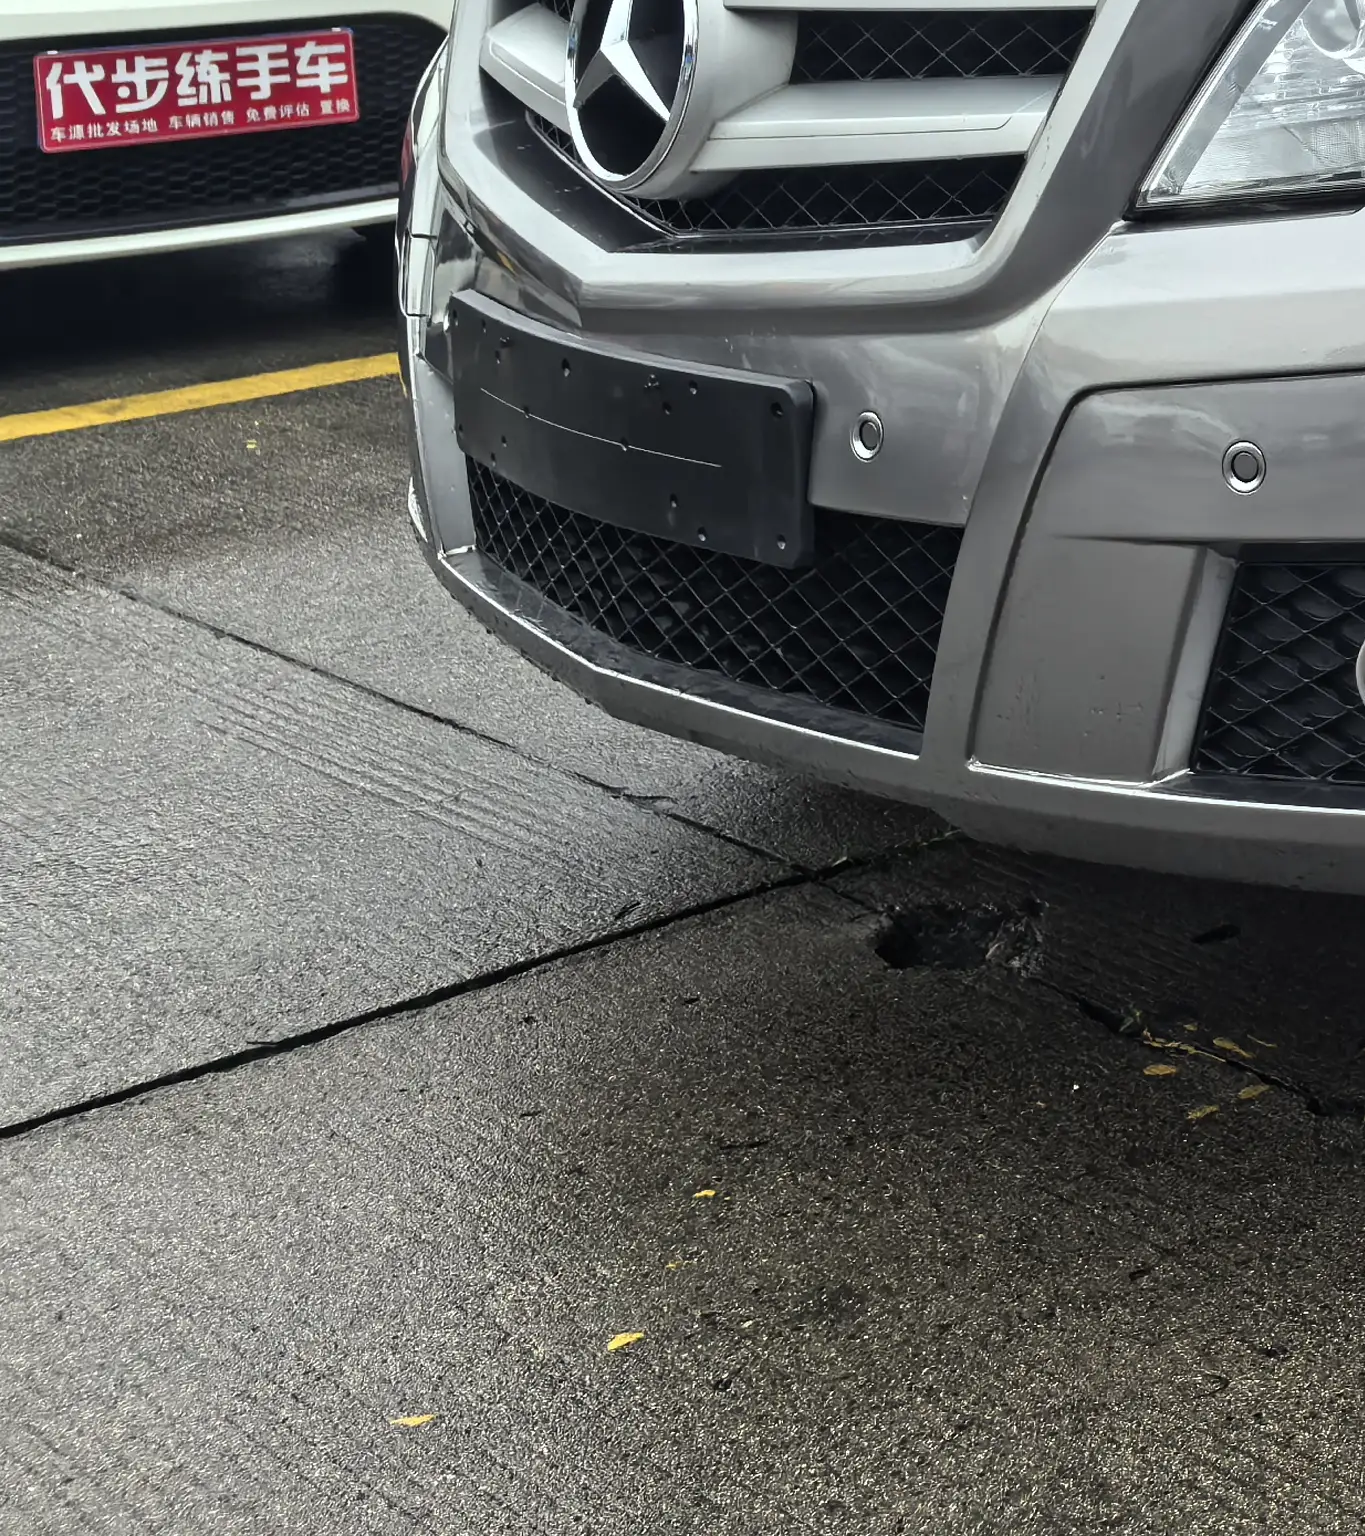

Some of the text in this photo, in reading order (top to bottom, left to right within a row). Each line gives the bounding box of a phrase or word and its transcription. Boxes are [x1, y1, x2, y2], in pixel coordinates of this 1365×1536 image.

[46, 41, 349, 120] 代步练手车
